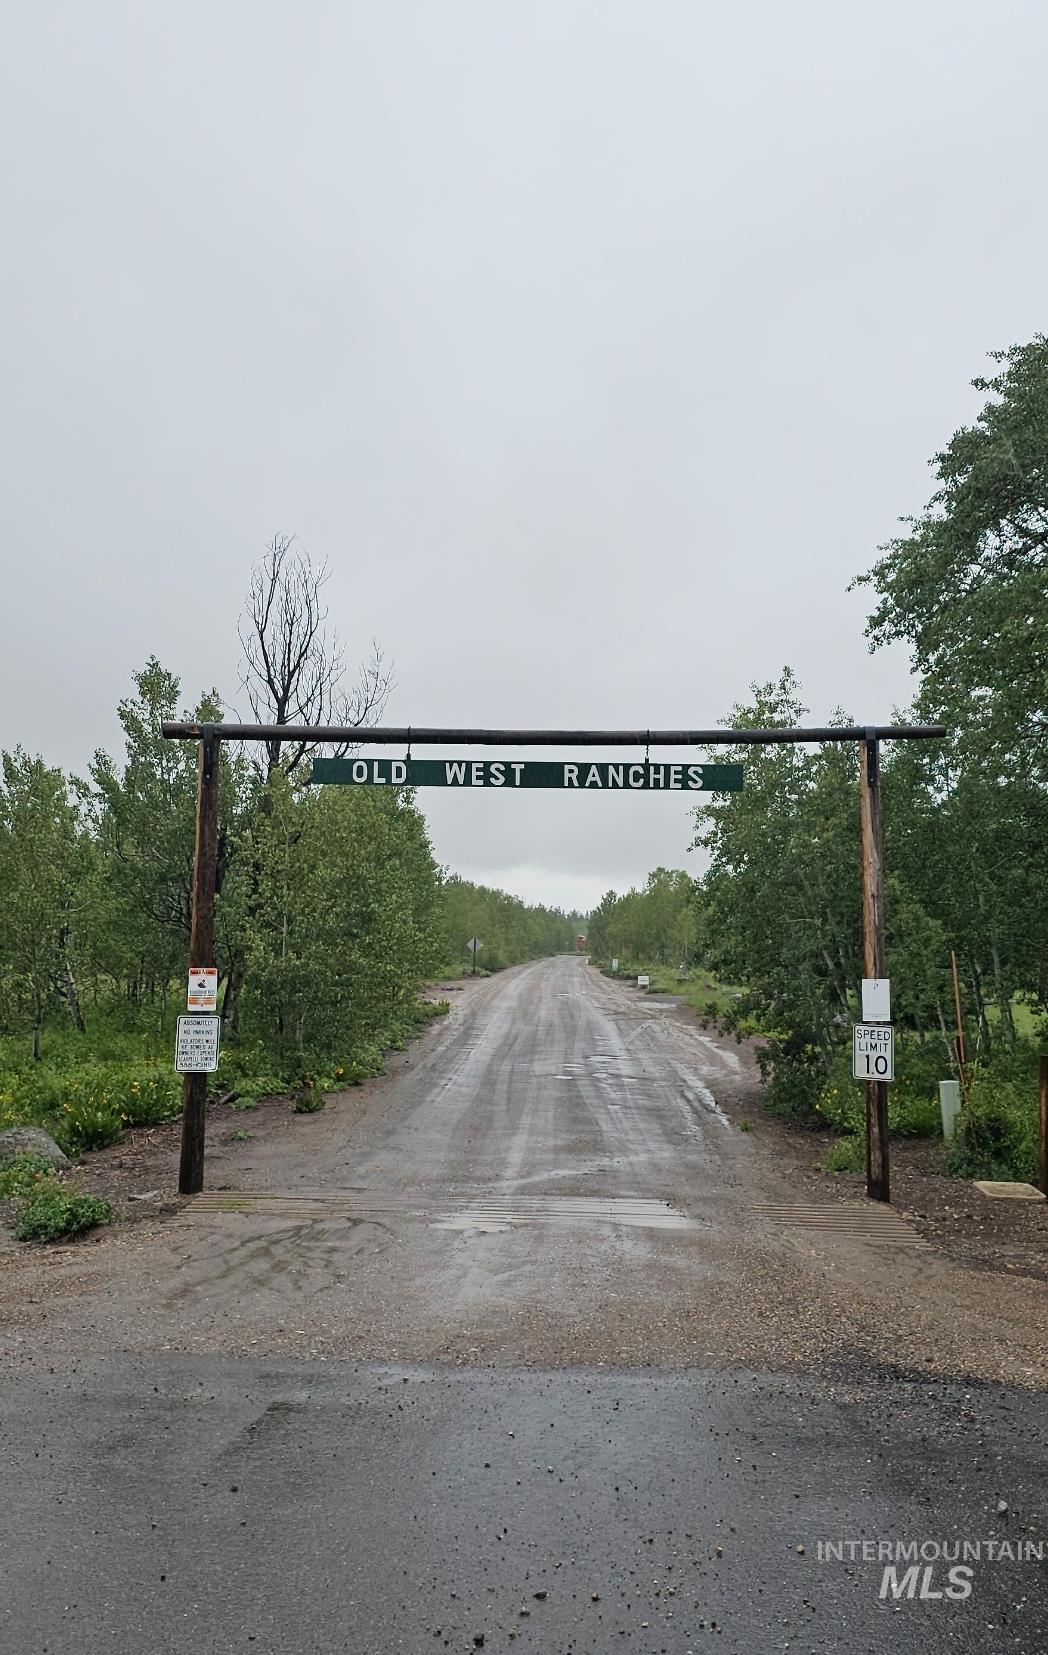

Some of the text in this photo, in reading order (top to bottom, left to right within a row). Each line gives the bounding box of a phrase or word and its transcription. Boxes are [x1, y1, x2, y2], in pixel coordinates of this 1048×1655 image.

[352, 761, 704, 789] OLD WEST RANCHES
[857, 1029, 890, 1041] SPEED
[859, 1041, 889, 1053] LIMIT
[865, 1054, 888, 1075] 10
